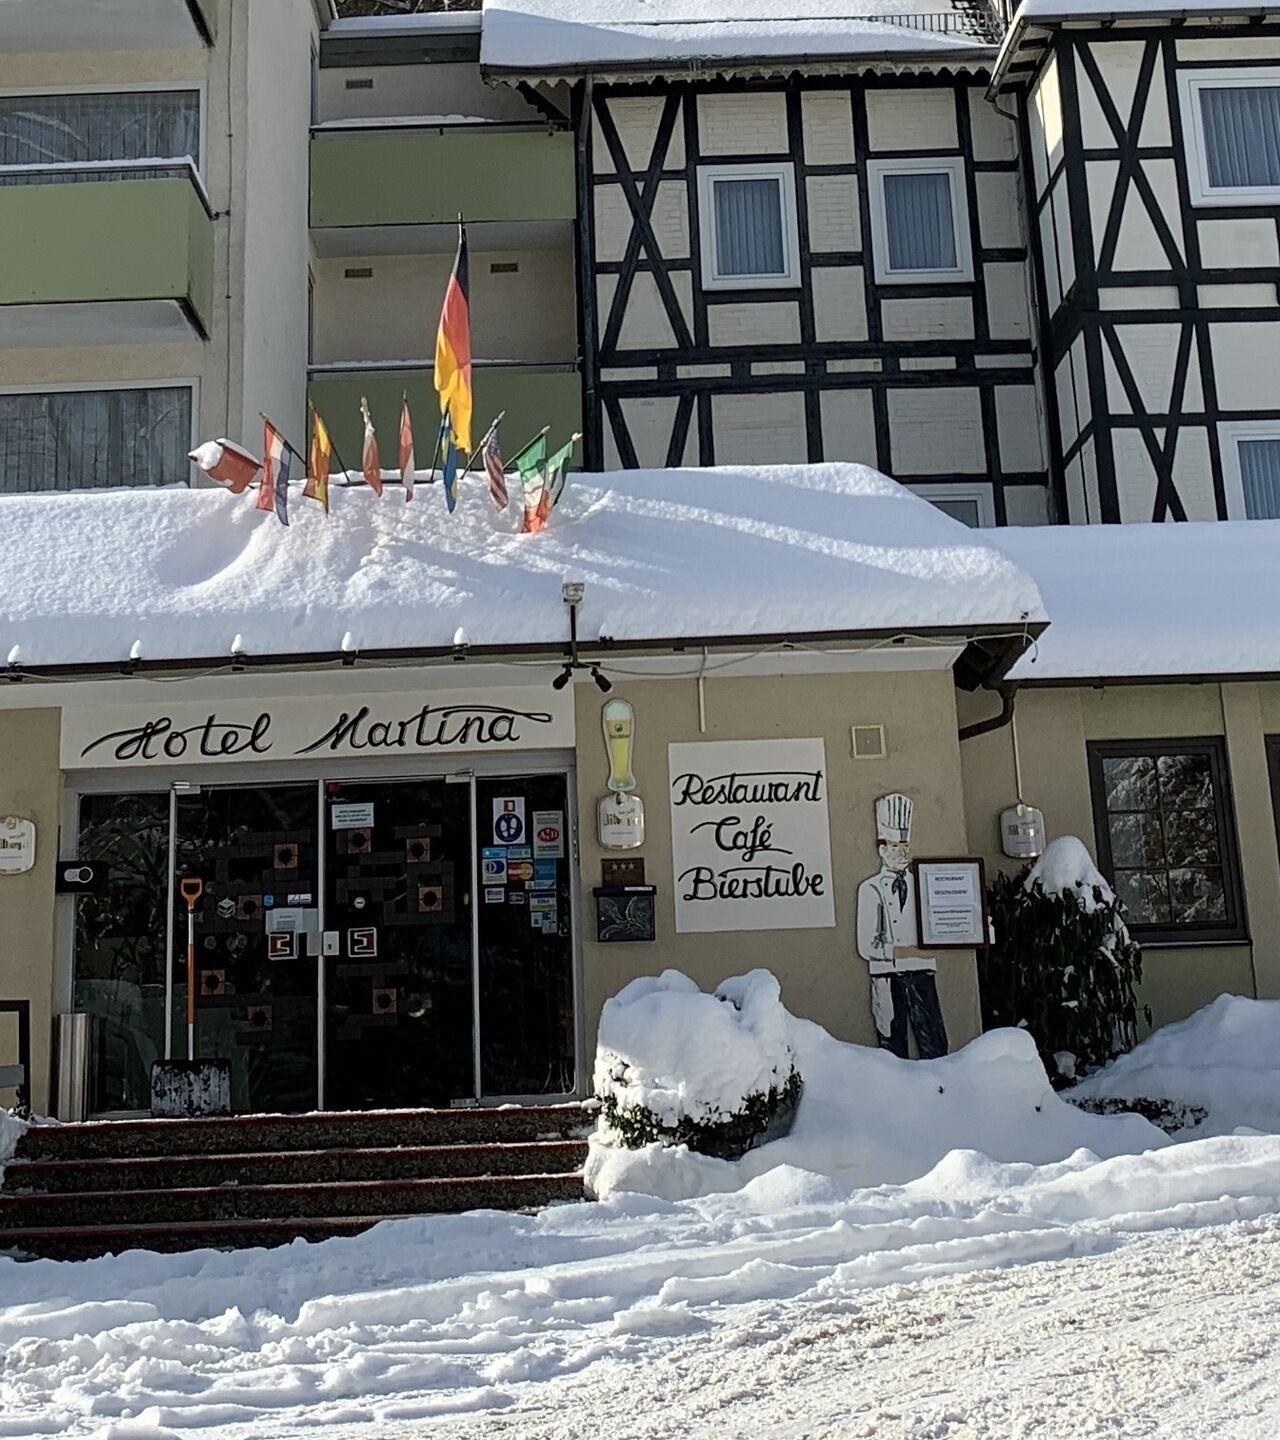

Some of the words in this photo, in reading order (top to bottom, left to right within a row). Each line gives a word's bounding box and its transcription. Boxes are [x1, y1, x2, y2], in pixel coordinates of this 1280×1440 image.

[81, 711, 274, 760] Hotel
[292, 703, 553, 755] Martina
[671, 770, 824, 807] Restaurant
[689, 815, 794, 862] Café
[677, 862, 825, 901] Bierstube
